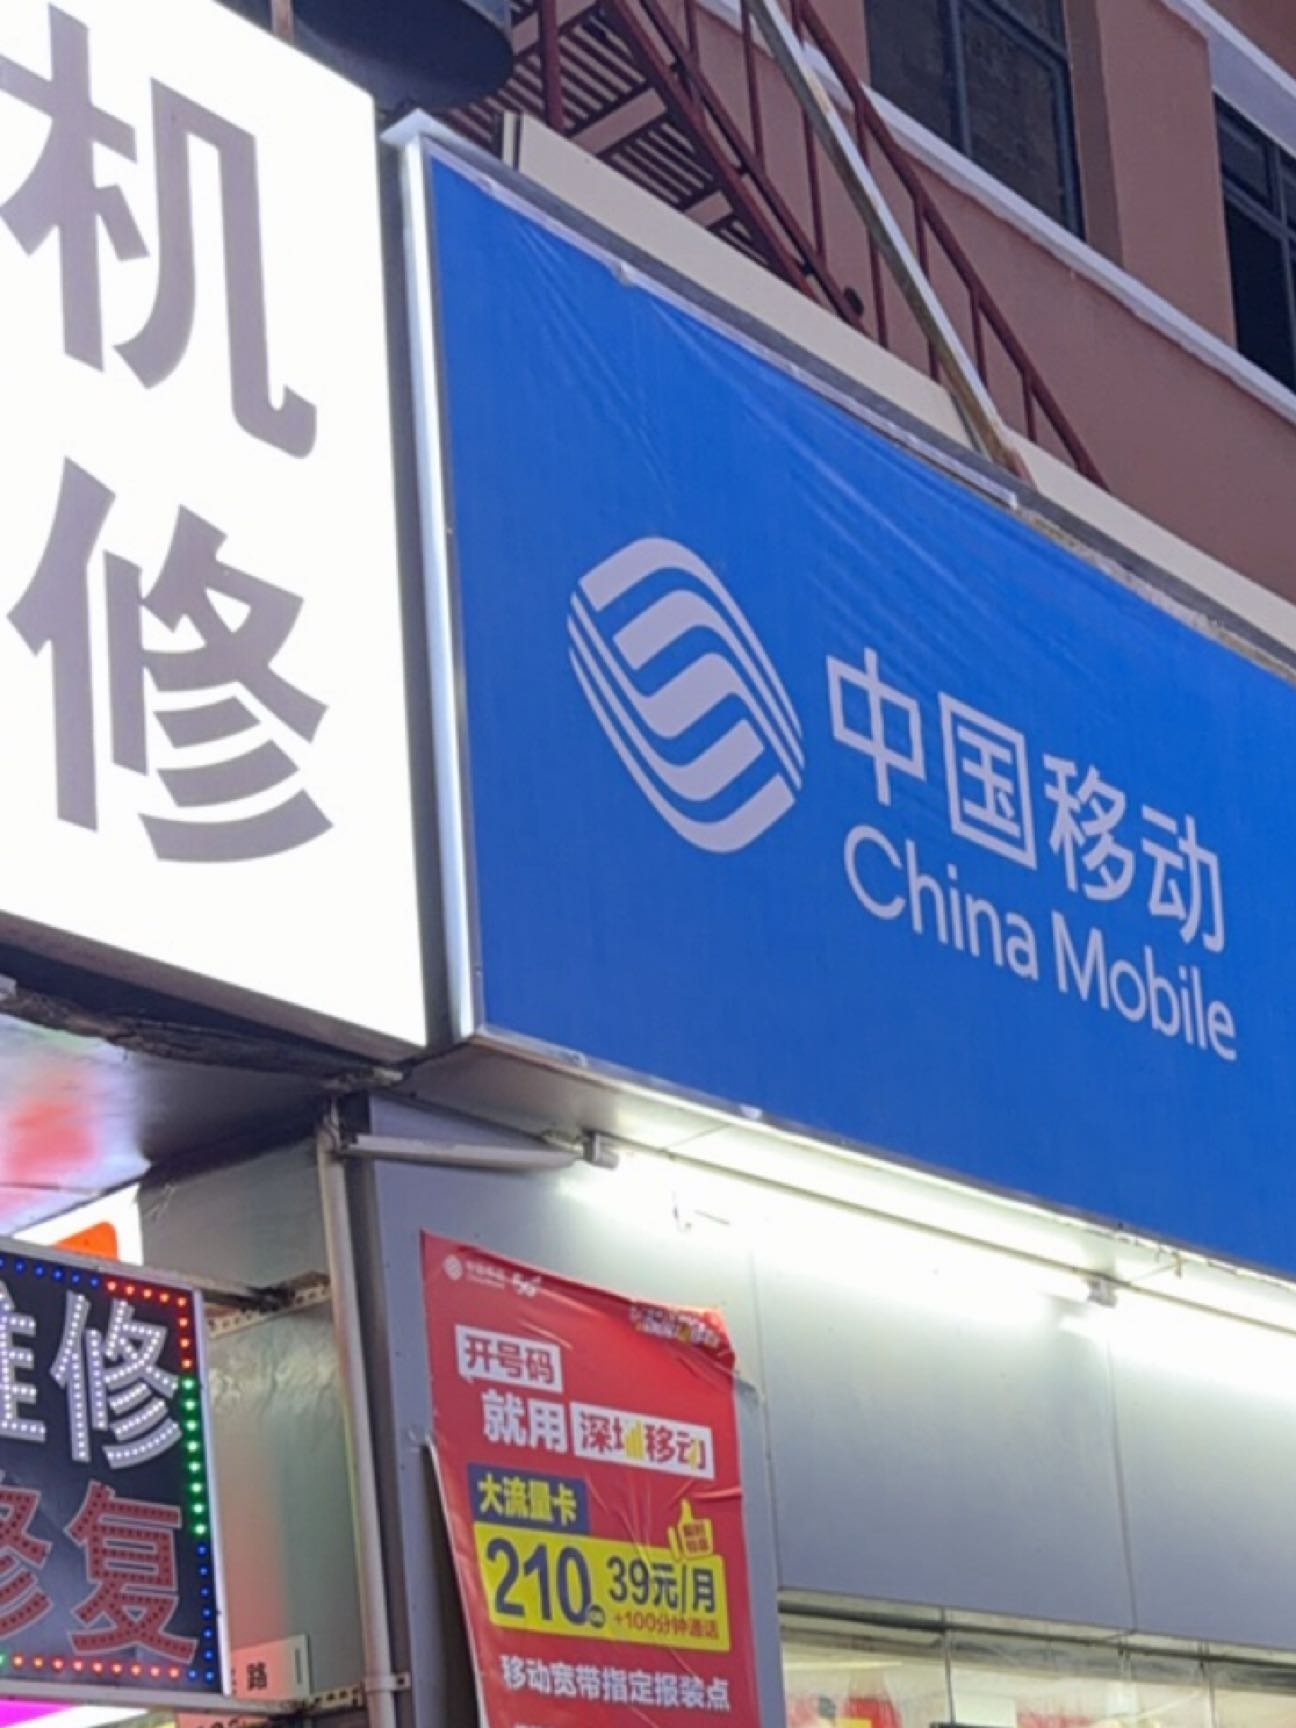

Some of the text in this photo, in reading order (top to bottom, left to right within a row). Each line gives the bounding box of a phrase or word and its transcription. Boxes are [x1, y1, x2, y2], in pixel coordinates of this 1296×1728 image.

[6, 455, 334, 864] 修
[826, 648, 1225, 954] 中国移动
[843, 824, 1238, 1063] China Mobile
[465, 1332, 554, 1385] 开号码
[482, 1388, 707, 1469] 就用 深圳移动
[477, 1473, 577, 1527] 大流量卡
[487, 1537, 717, 1626] 210 39元/月
[500, 1654, 732, 1711] 移动宽带指定报装点
